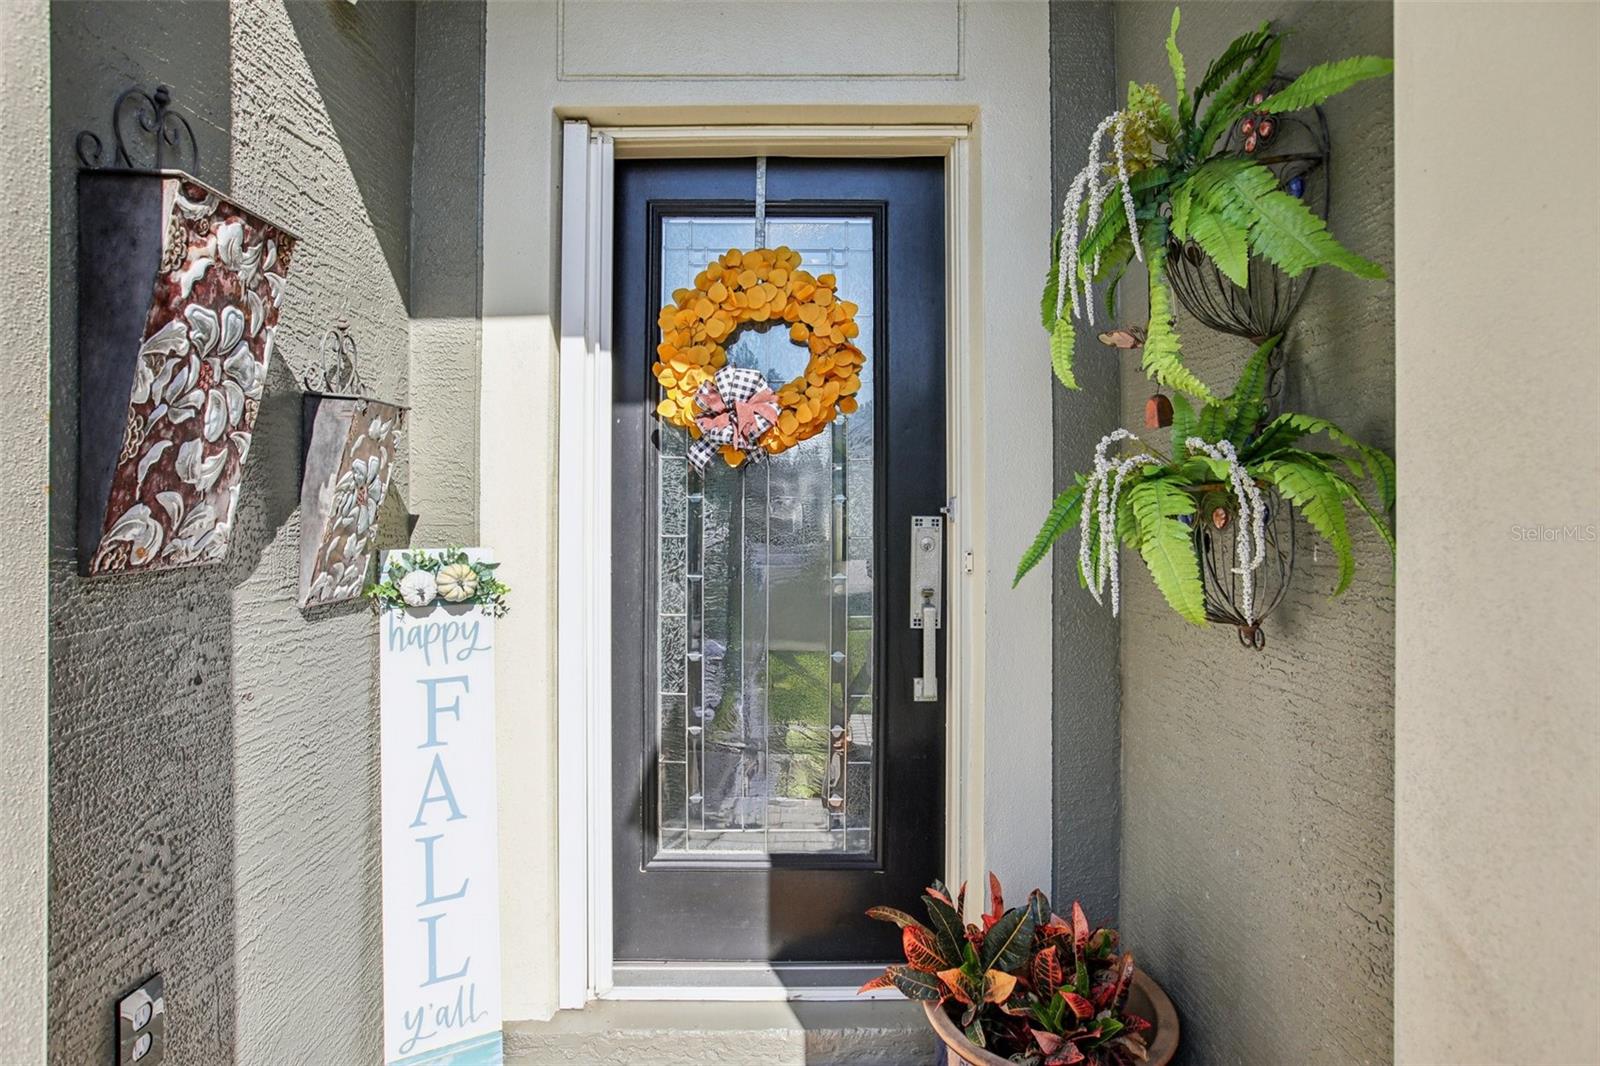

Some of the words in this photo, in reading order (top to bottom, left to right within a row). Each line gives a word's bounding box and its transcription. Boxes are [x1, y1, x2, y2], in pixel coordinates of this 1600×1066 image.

[389, 611, 491, 666] happy
[409, 675, 471, 988] FALL
[399, 983, 488, 1054] y'all
